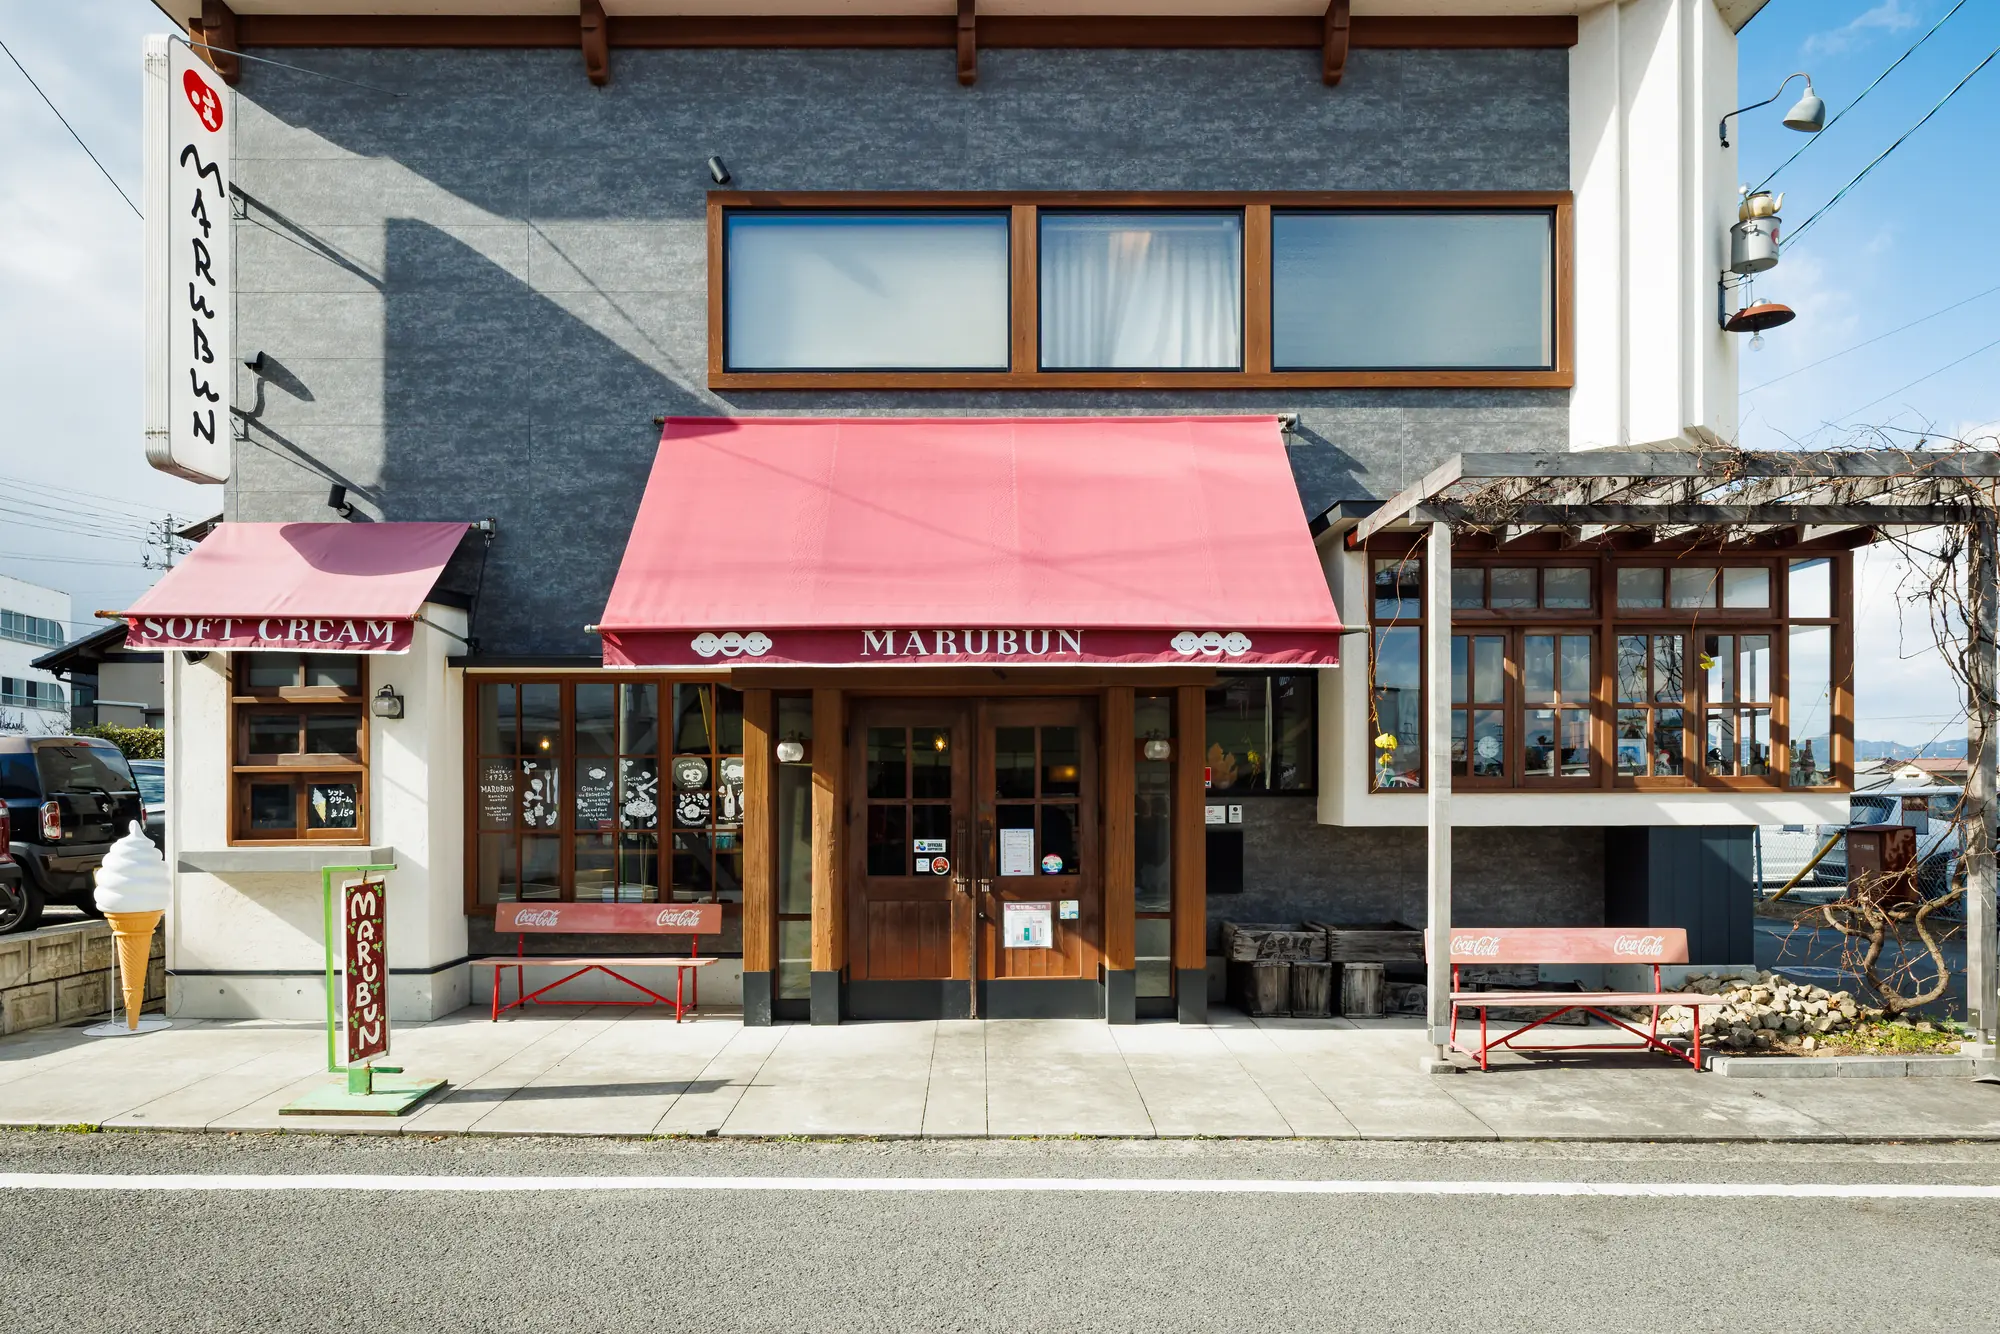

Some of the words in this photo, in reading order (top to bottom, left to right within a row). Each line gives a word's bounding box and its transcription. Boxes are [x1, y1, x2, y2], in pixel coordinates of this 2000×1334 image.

[180, 143, 225, 445] MARUBUN
[141, 618, 243, 641] SOFT
[258, 619, 396, 644] CREAM
[860, 629, 1084, 656] MARUBUN
[480, 785, 515, 793] MARUBUN
[350, 891, 381, 1051] MARUBUN
